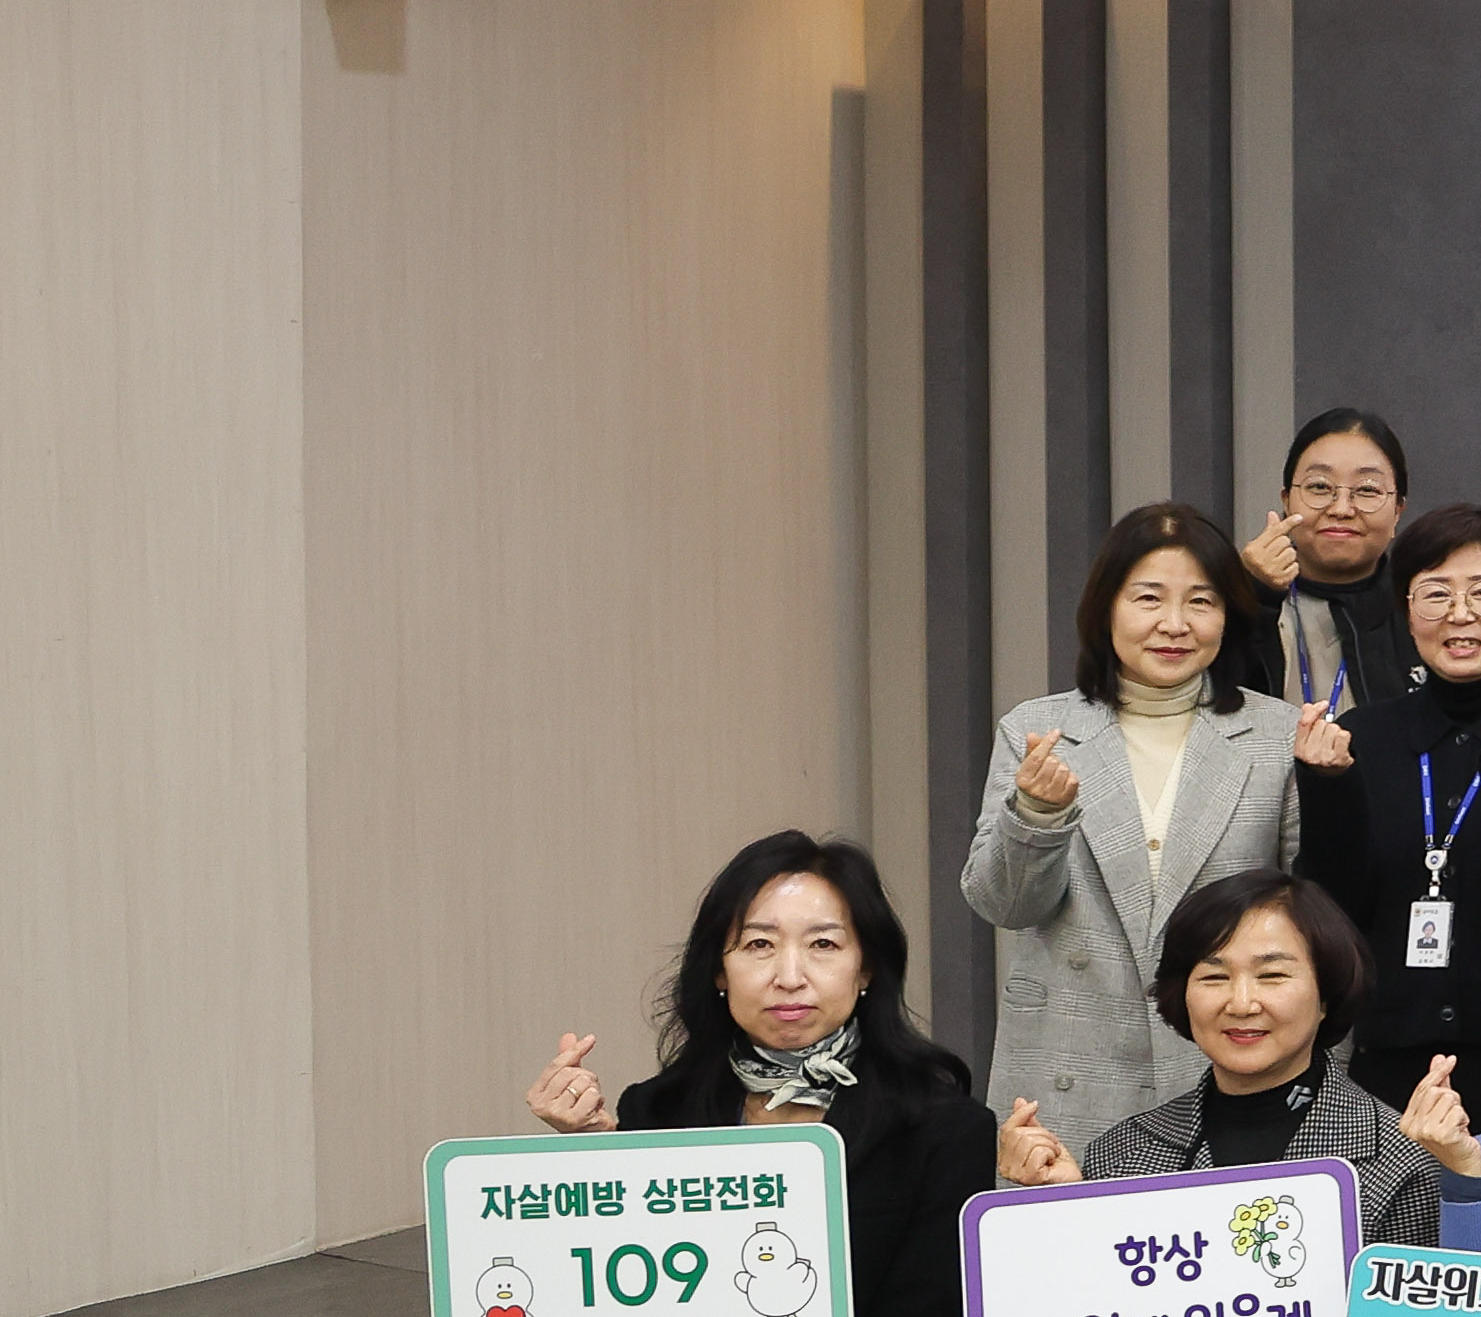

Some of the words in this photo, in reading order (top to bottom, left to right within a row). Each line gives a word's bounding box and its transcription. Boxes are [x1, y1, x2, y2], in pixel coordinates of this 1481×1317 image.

[480, 1180, 627, 1221] 자살예방
[642, 1173, 788, 1214] 상담전화
[570, 1241, 709, 1308] 109
[1114, 1231, 1209, 1287] 항상
